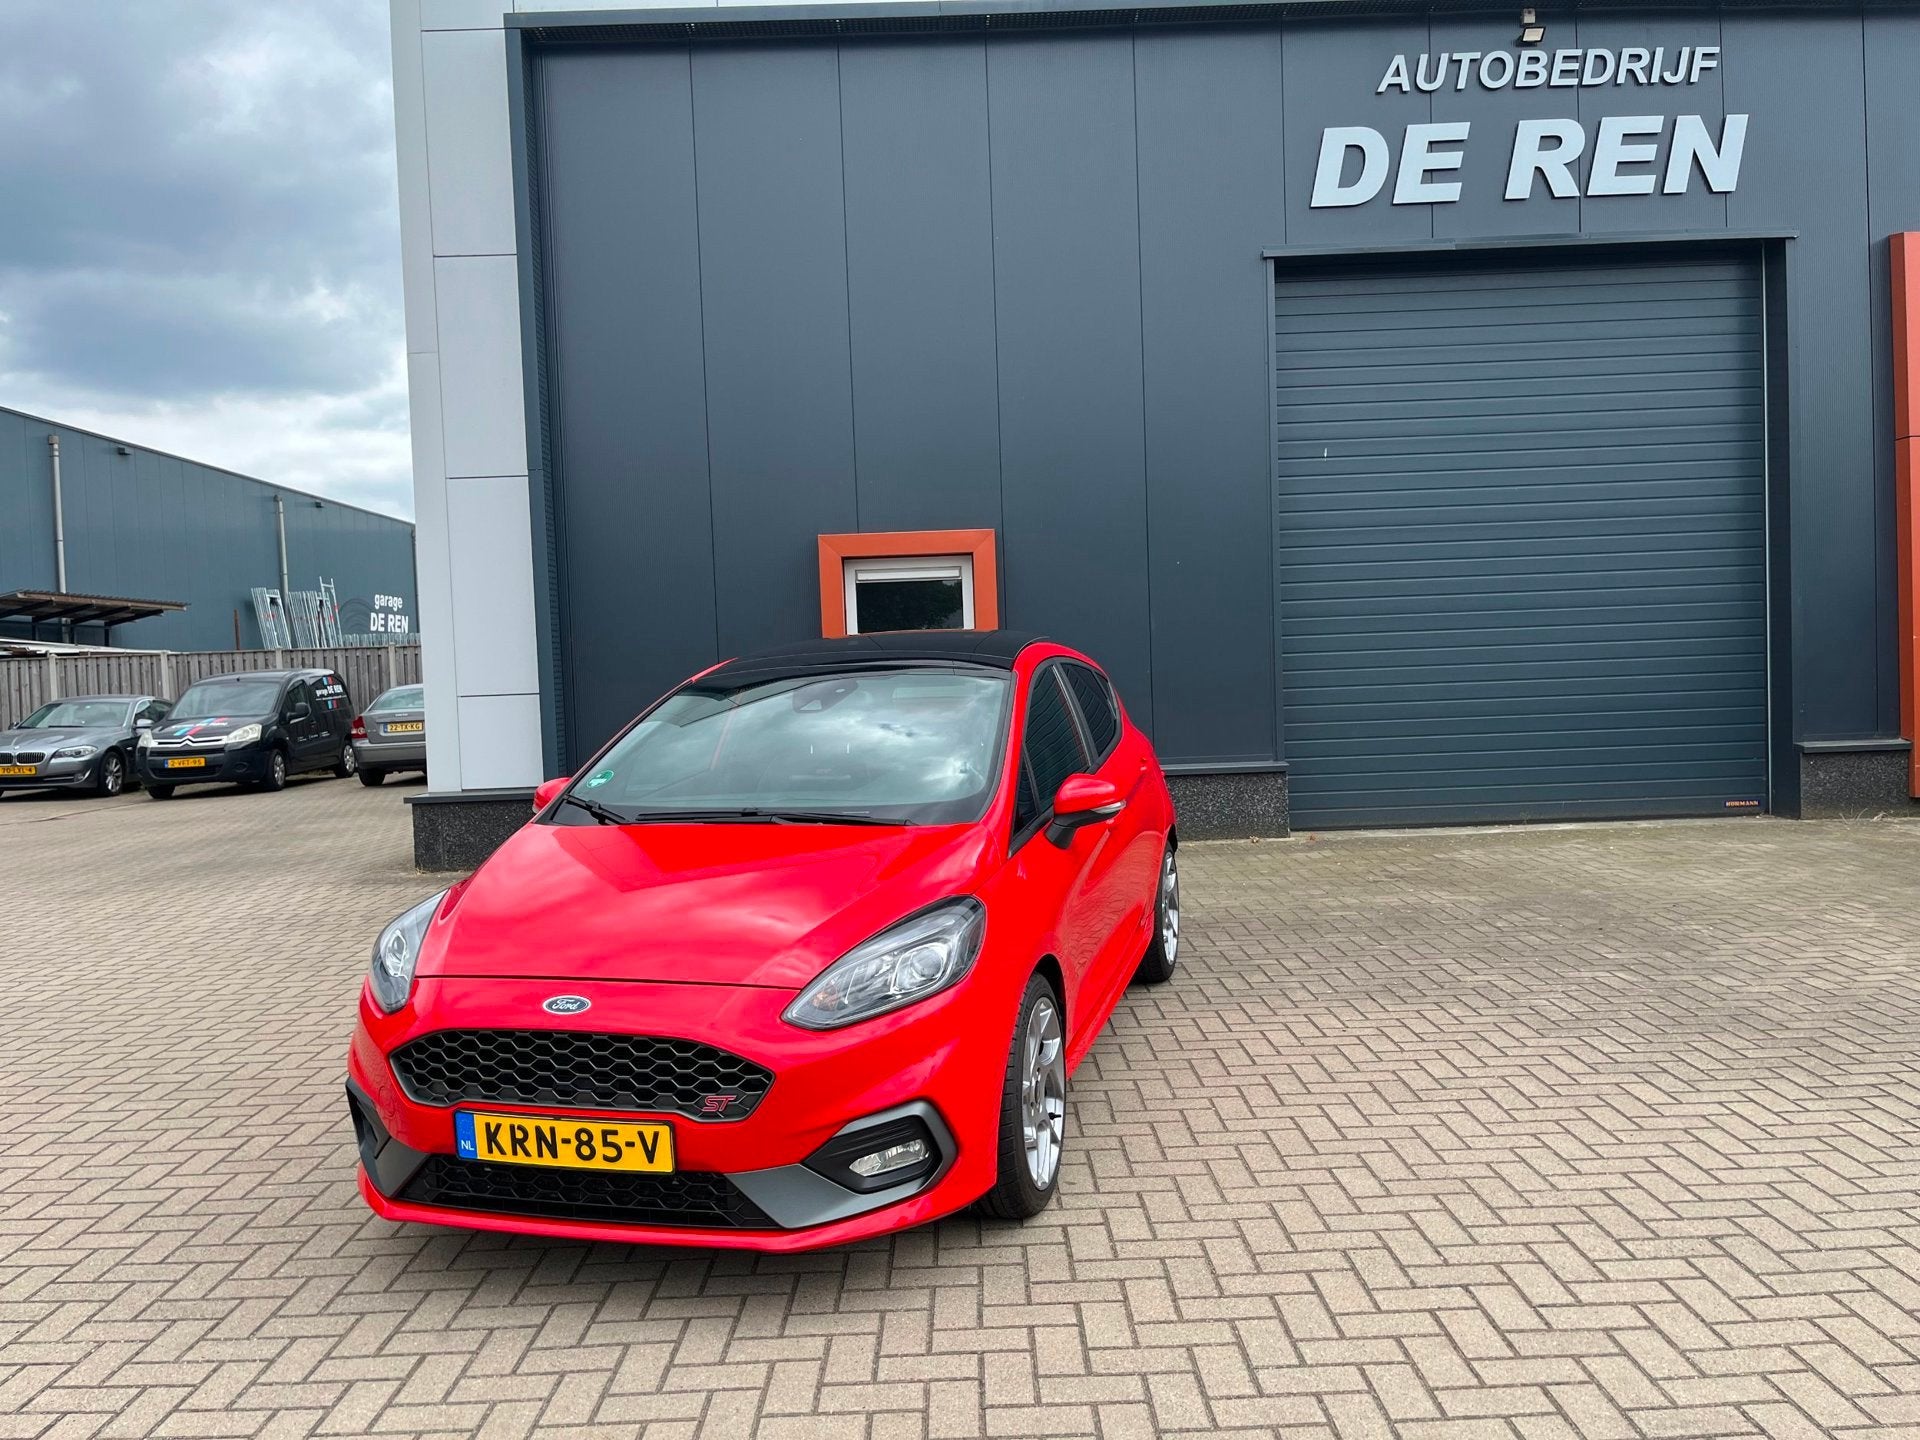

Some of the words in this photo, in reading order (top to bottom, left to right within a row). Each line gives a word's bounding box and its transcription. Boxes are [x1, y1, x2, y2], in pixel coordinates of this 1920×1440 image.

[1377, 46, 1720, 94] AUTOBEDRIJF
[1310, 121, 1471, 208] DE
[1504, 113, 1749, 200] REN
[374, 594, 403, 611] garage
[370, 612, 385, 631] DE
[387, 614, 409, 633] REN
[552, 998, 581, 1010] Ford
[702, 1095, 738, 1112] ST
[461, 1139, 475, 1151] NL
[484, 1121, 660, 1165] KRN-85-V
